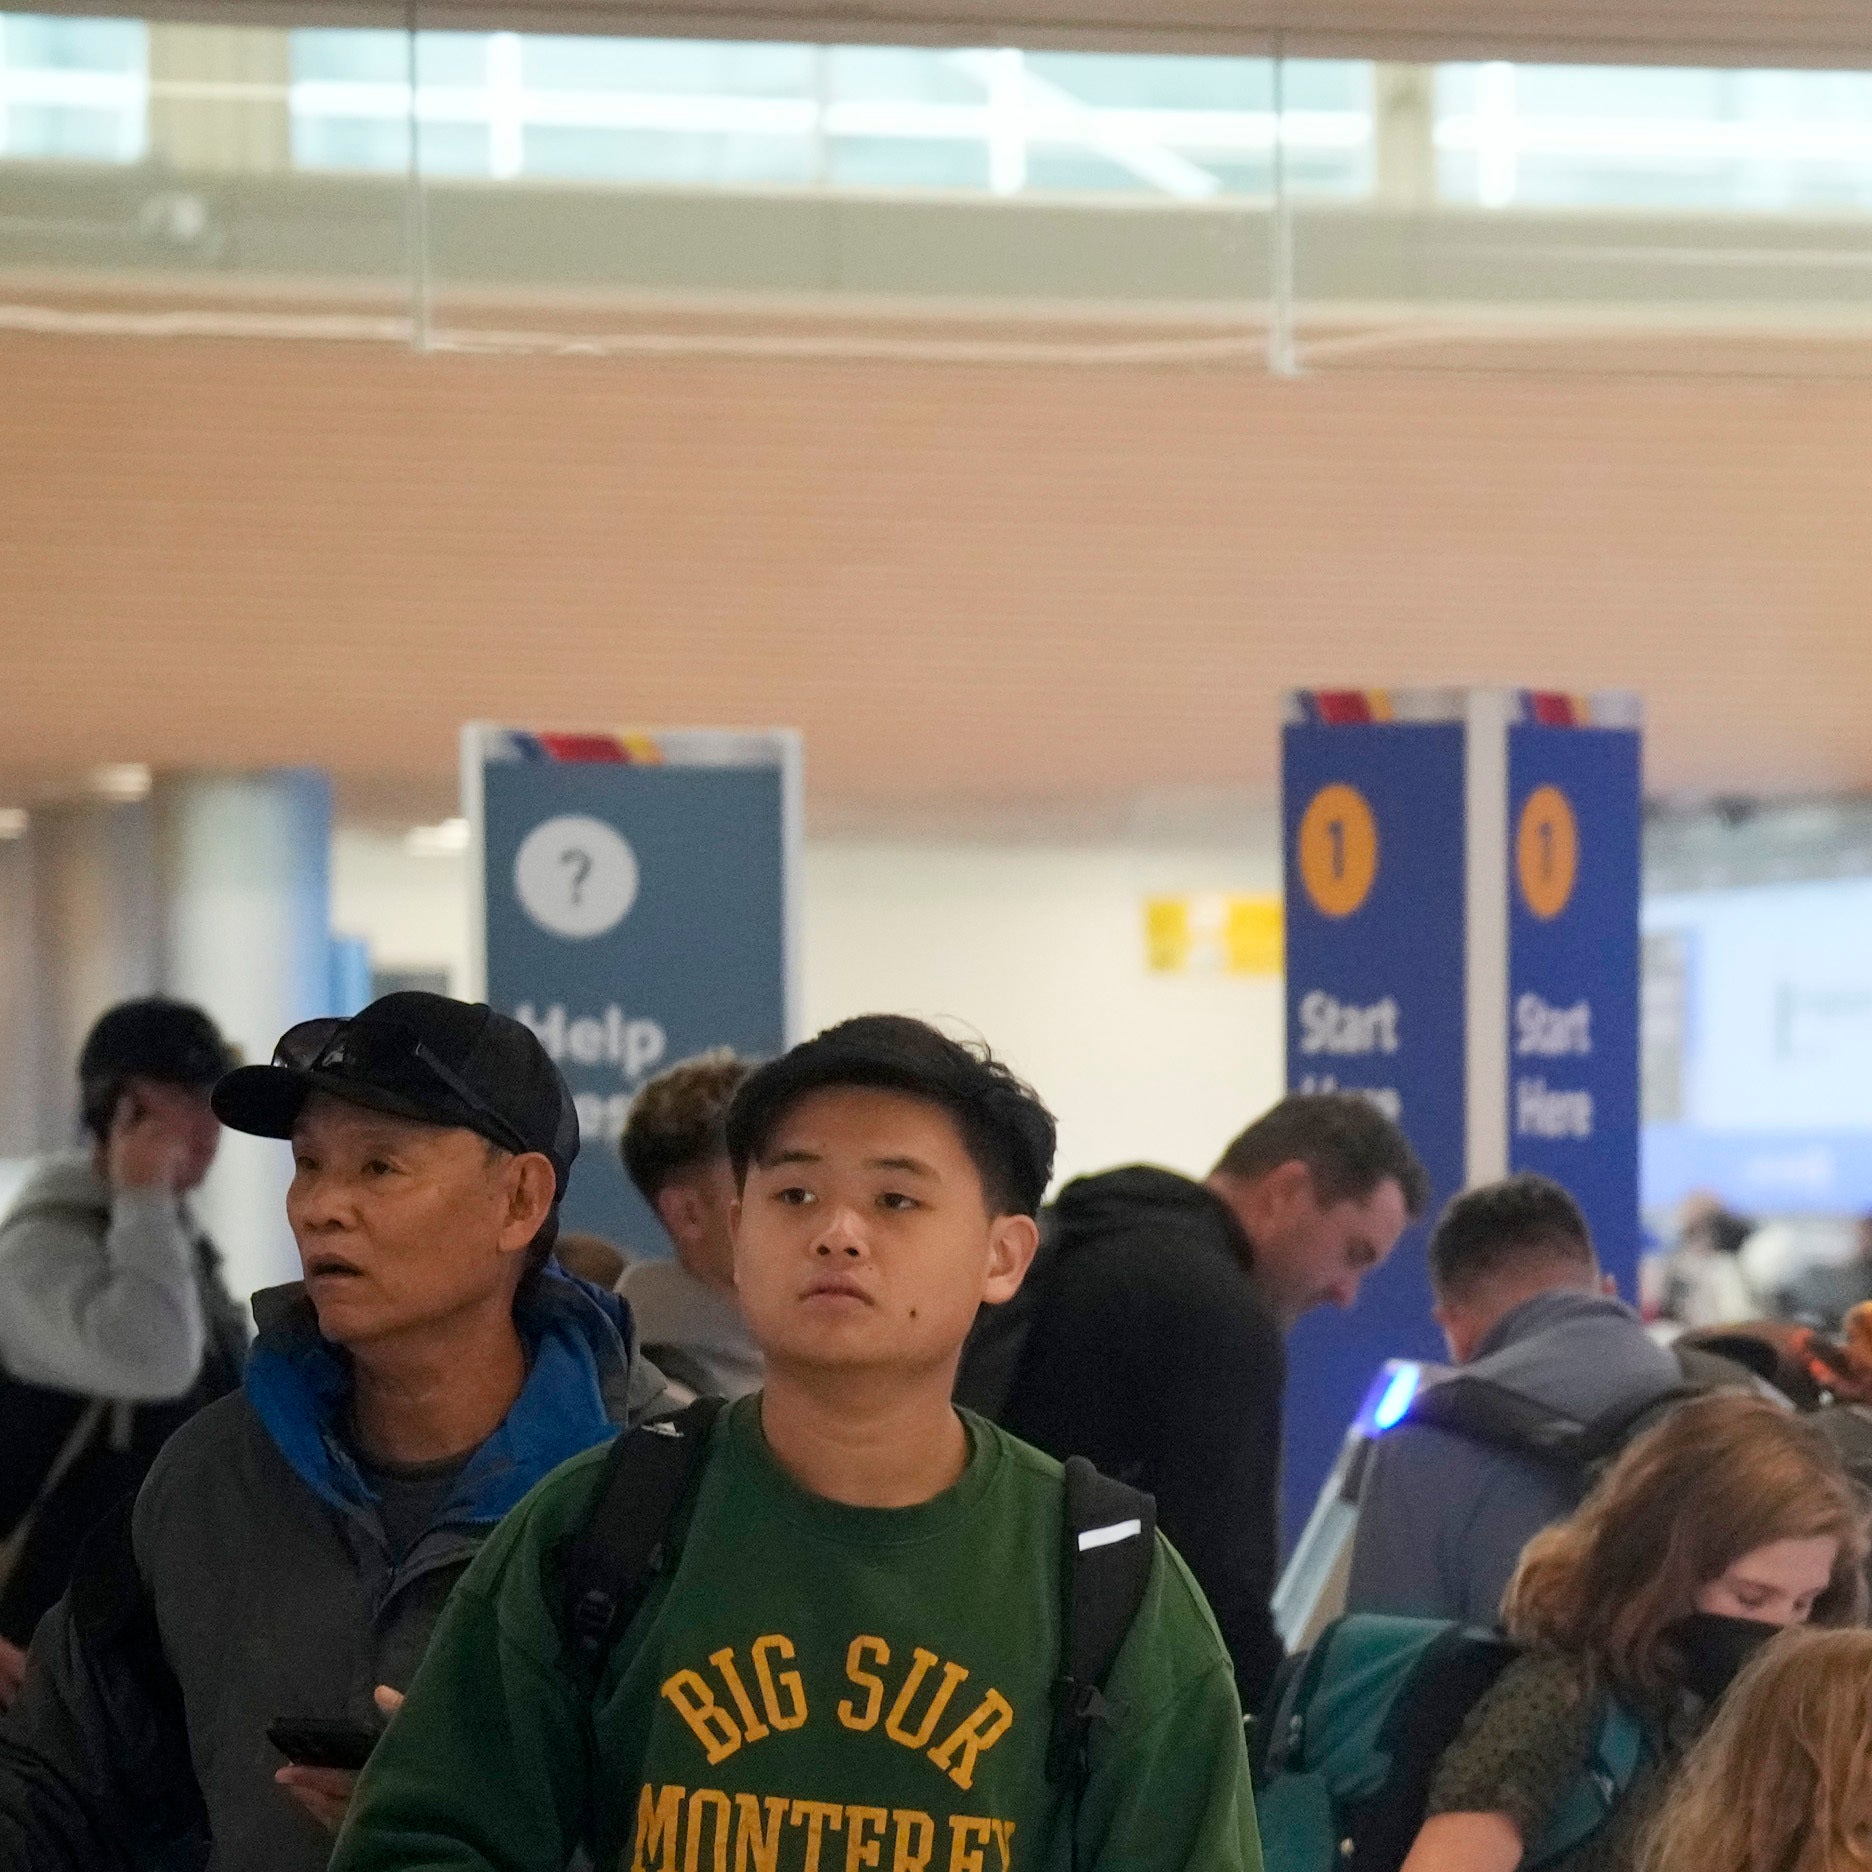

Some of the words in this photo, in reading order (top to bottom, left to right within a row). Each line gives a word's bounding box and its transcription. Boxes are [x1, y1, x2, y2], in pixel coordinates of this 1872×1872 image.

[1328, 818, 1346, 880] 1
[515, 1002, 667, 1078] Help
[1300, 988, 1398, 1055] Start
[1516, 991, 1592, 1056] Start
[1516, 1076, 1593, 1141] Here
[660, 1633, 809, 1766] BIG
[836, 1633, 1015, 1792] SUR
